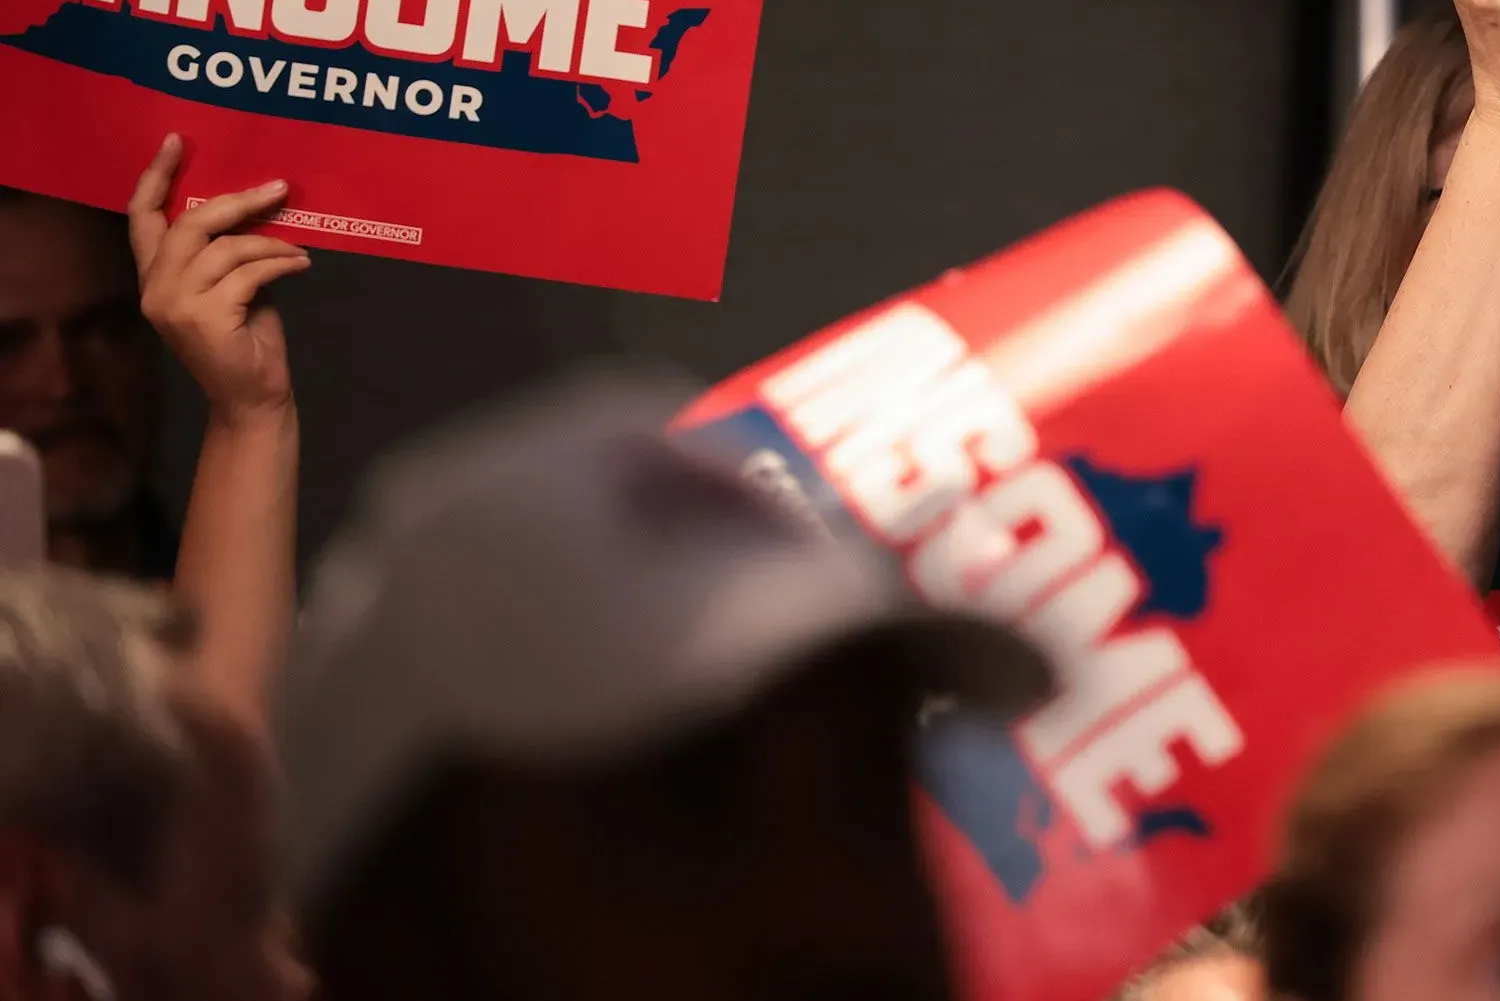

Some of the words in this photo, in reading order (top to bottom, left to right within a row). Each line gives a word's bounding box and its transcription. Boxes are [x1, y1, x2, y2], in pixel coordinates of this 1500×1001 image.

[167, 44, 483, 123] GOVERNOR
[323, 216, 348, 231] FOR
[349, 220, 418, 241] GOVERNOR
